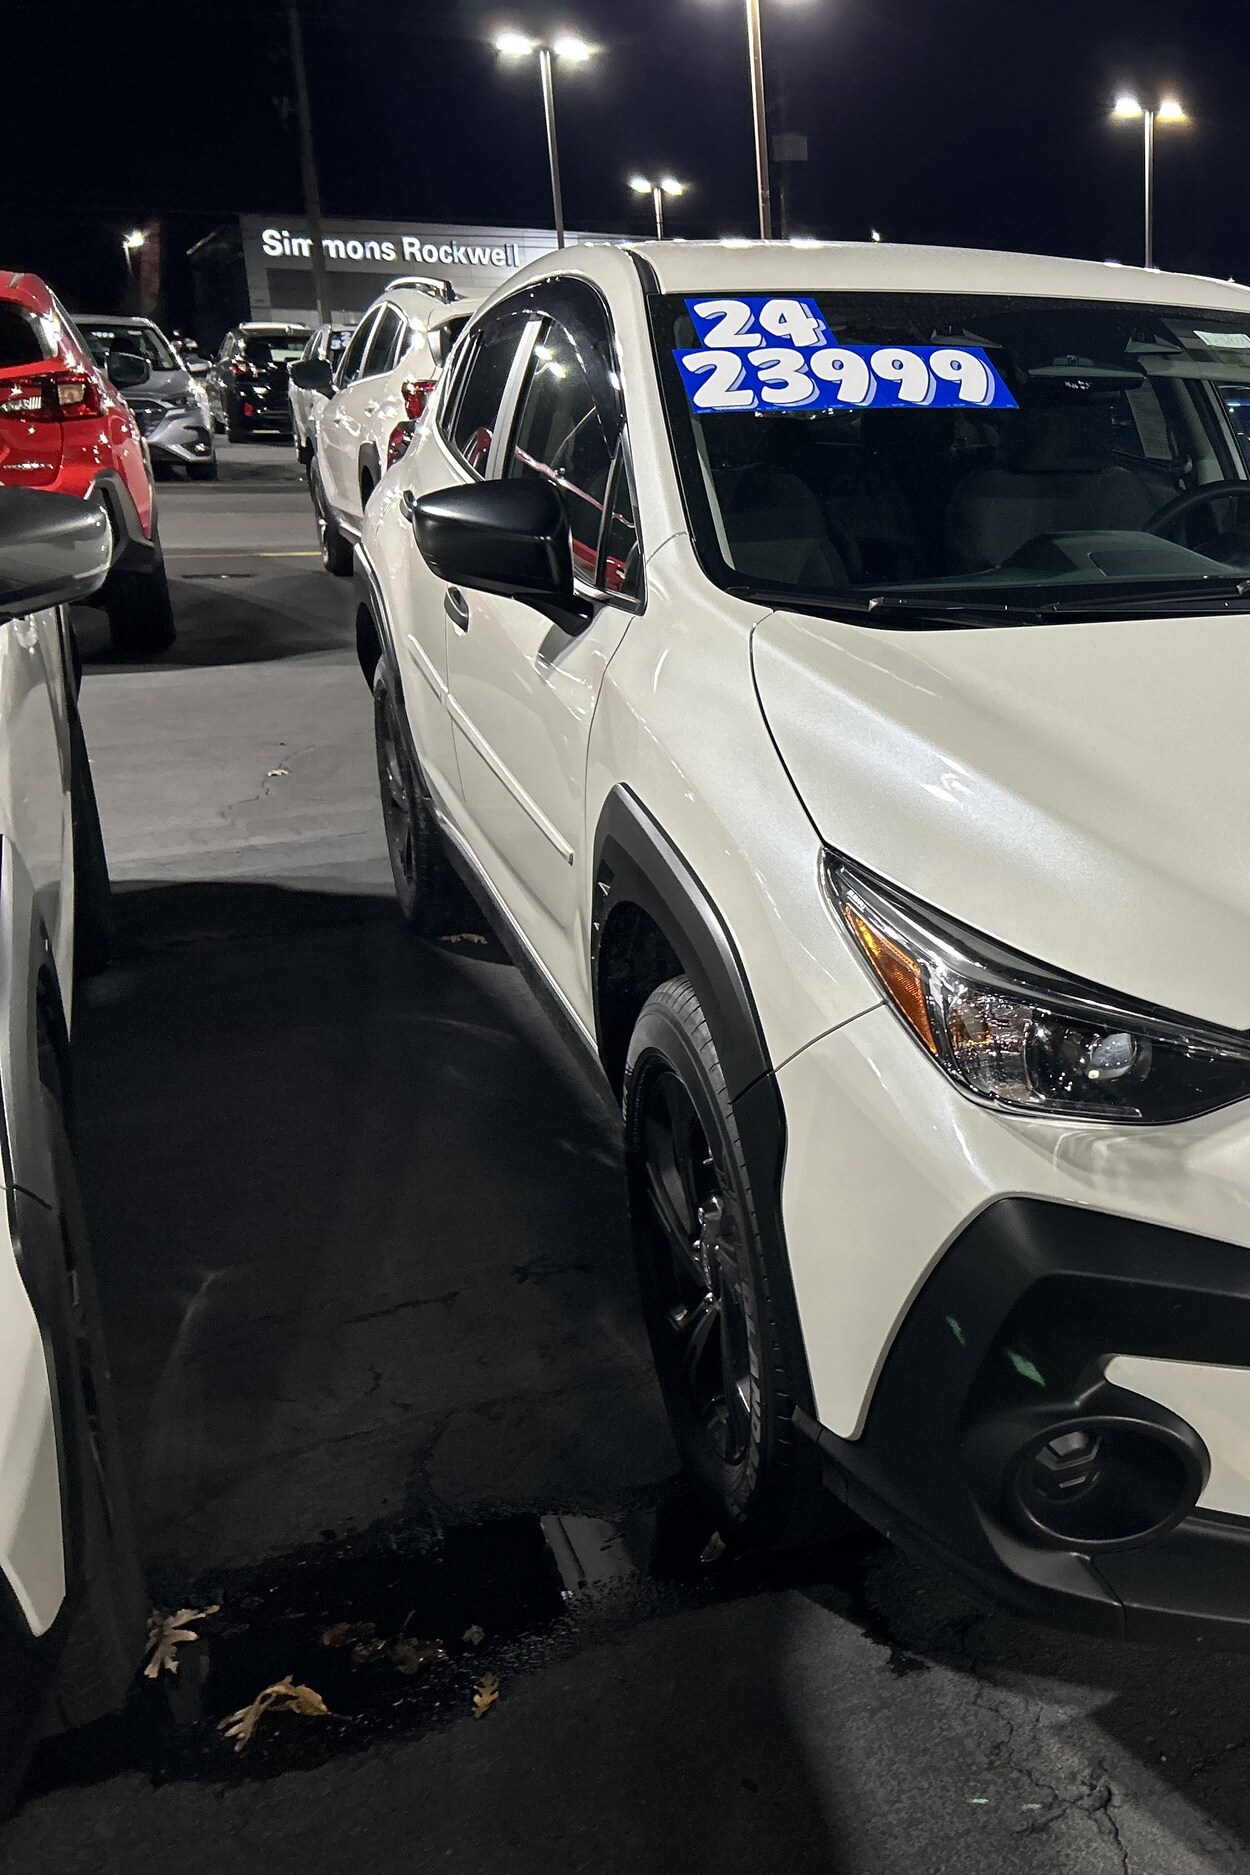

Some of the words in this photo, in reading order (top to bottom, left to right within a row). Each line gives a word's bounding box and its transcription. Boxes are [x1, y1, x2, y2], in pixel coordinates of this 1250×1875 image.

[262, 229, 397, 262] Simmons
[401, 236, 520, 267] Rockwell
[693, 299, 826, 348] 24
[682, 348, 996, 409] 23999
